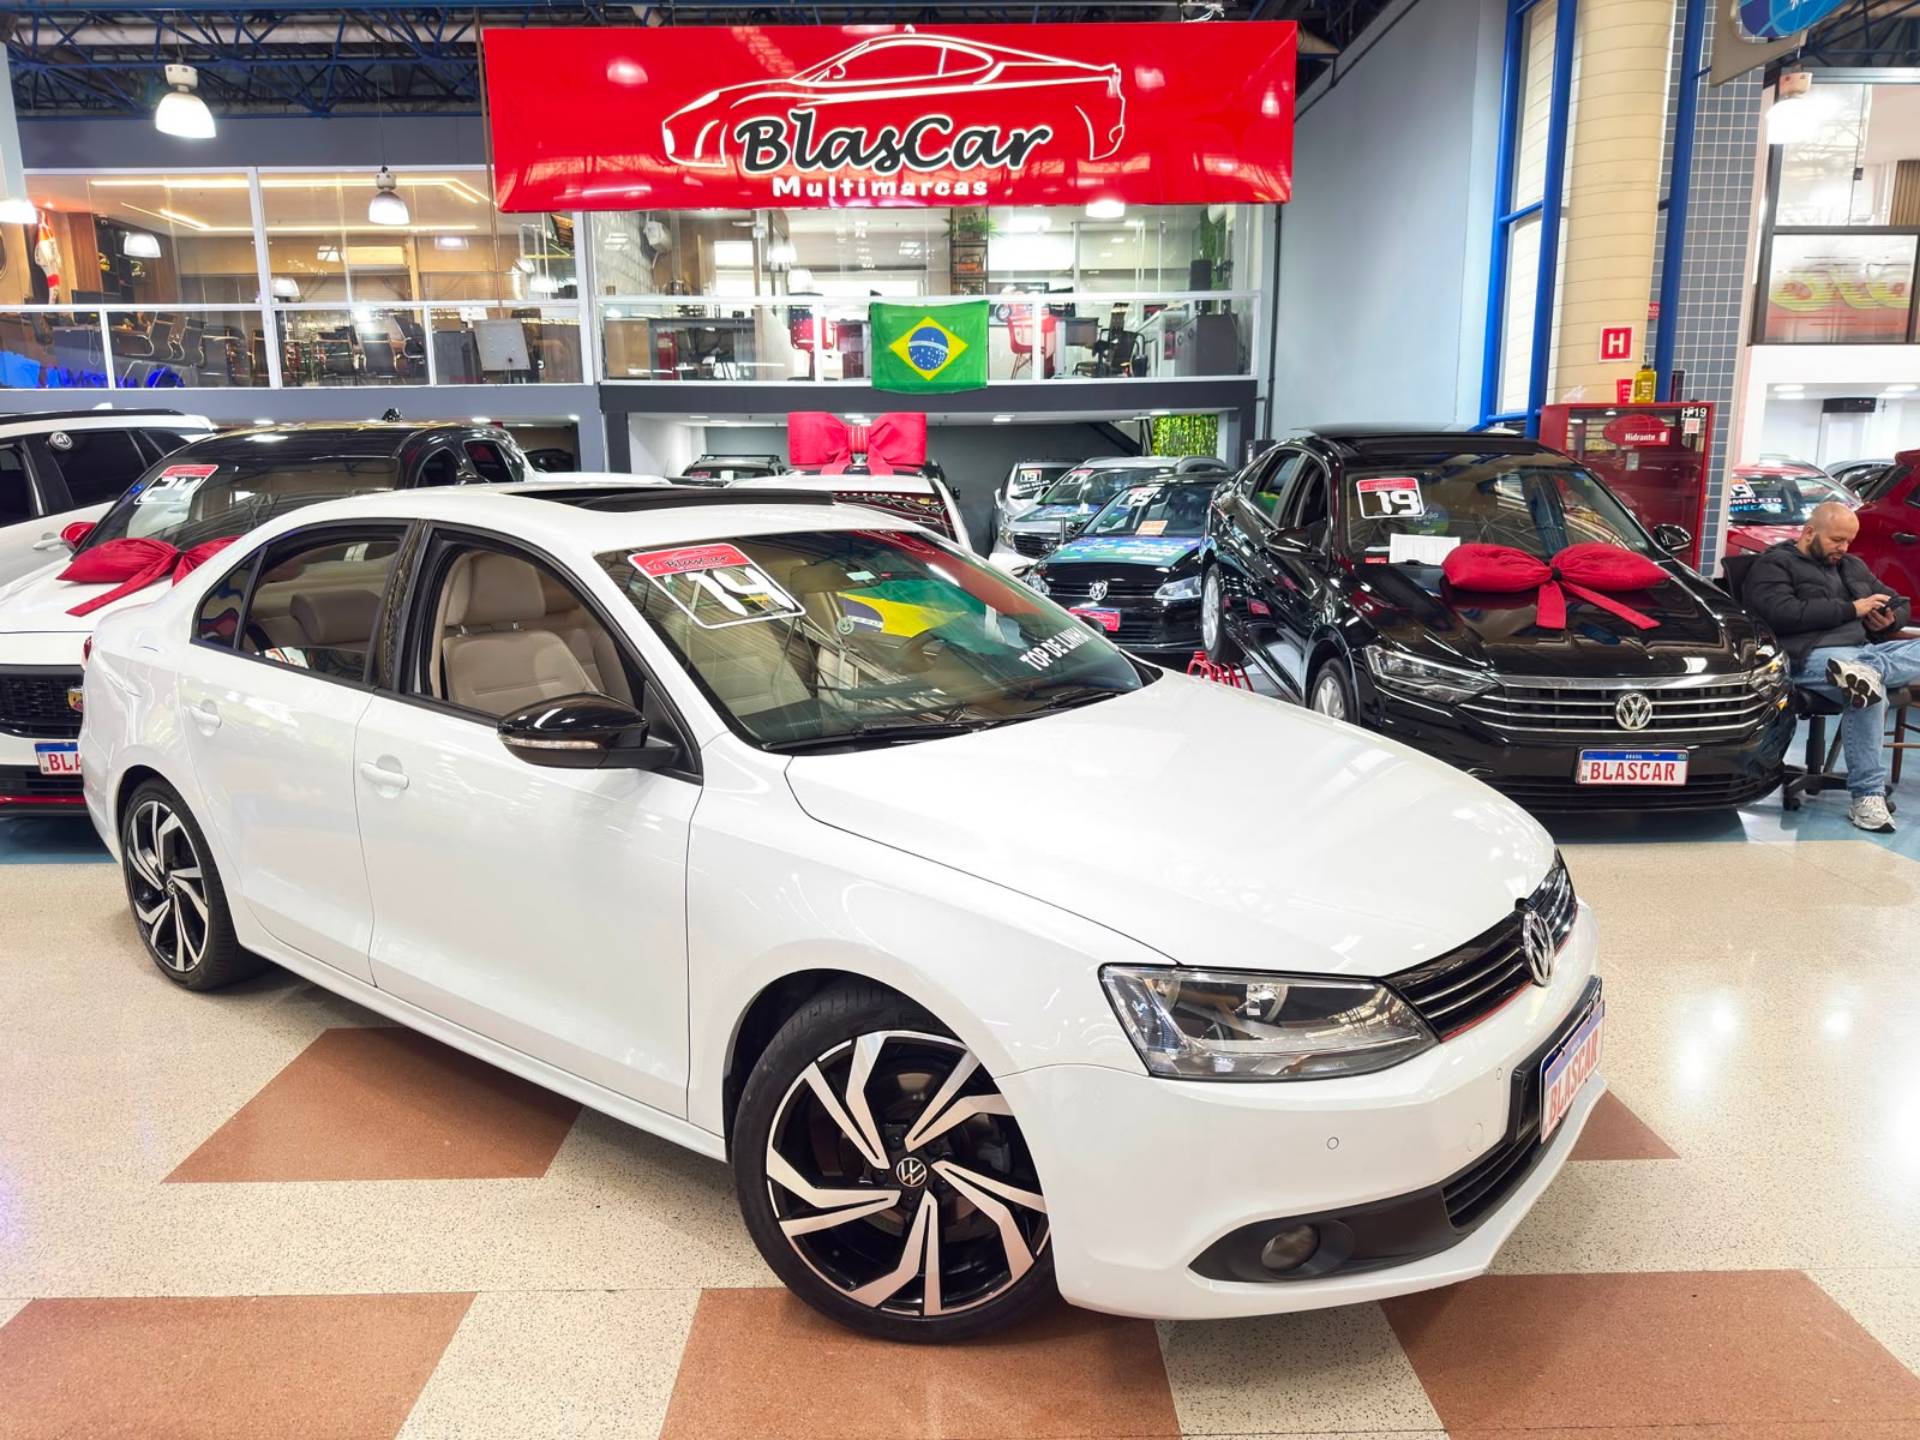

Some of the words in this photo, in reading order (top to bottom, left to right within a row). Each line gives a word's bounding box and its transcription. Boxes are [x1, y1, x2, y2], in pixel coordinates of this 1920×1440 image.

[734, 107, 1052, 174] BlasCar
[772, 176, 988, 199] Multimarcas
[1607, 333, 1625, 355] H
[1625, 431, 1656, 442] Hidrante
[1375, 490, 1421, 515] 19
[684, 566, 796, 617] 14
[1019, 647, 1053, 672] TOP
[1040, 638, 1069, 658] DE
[1590, 761, 1675, 781] BLASCAR
